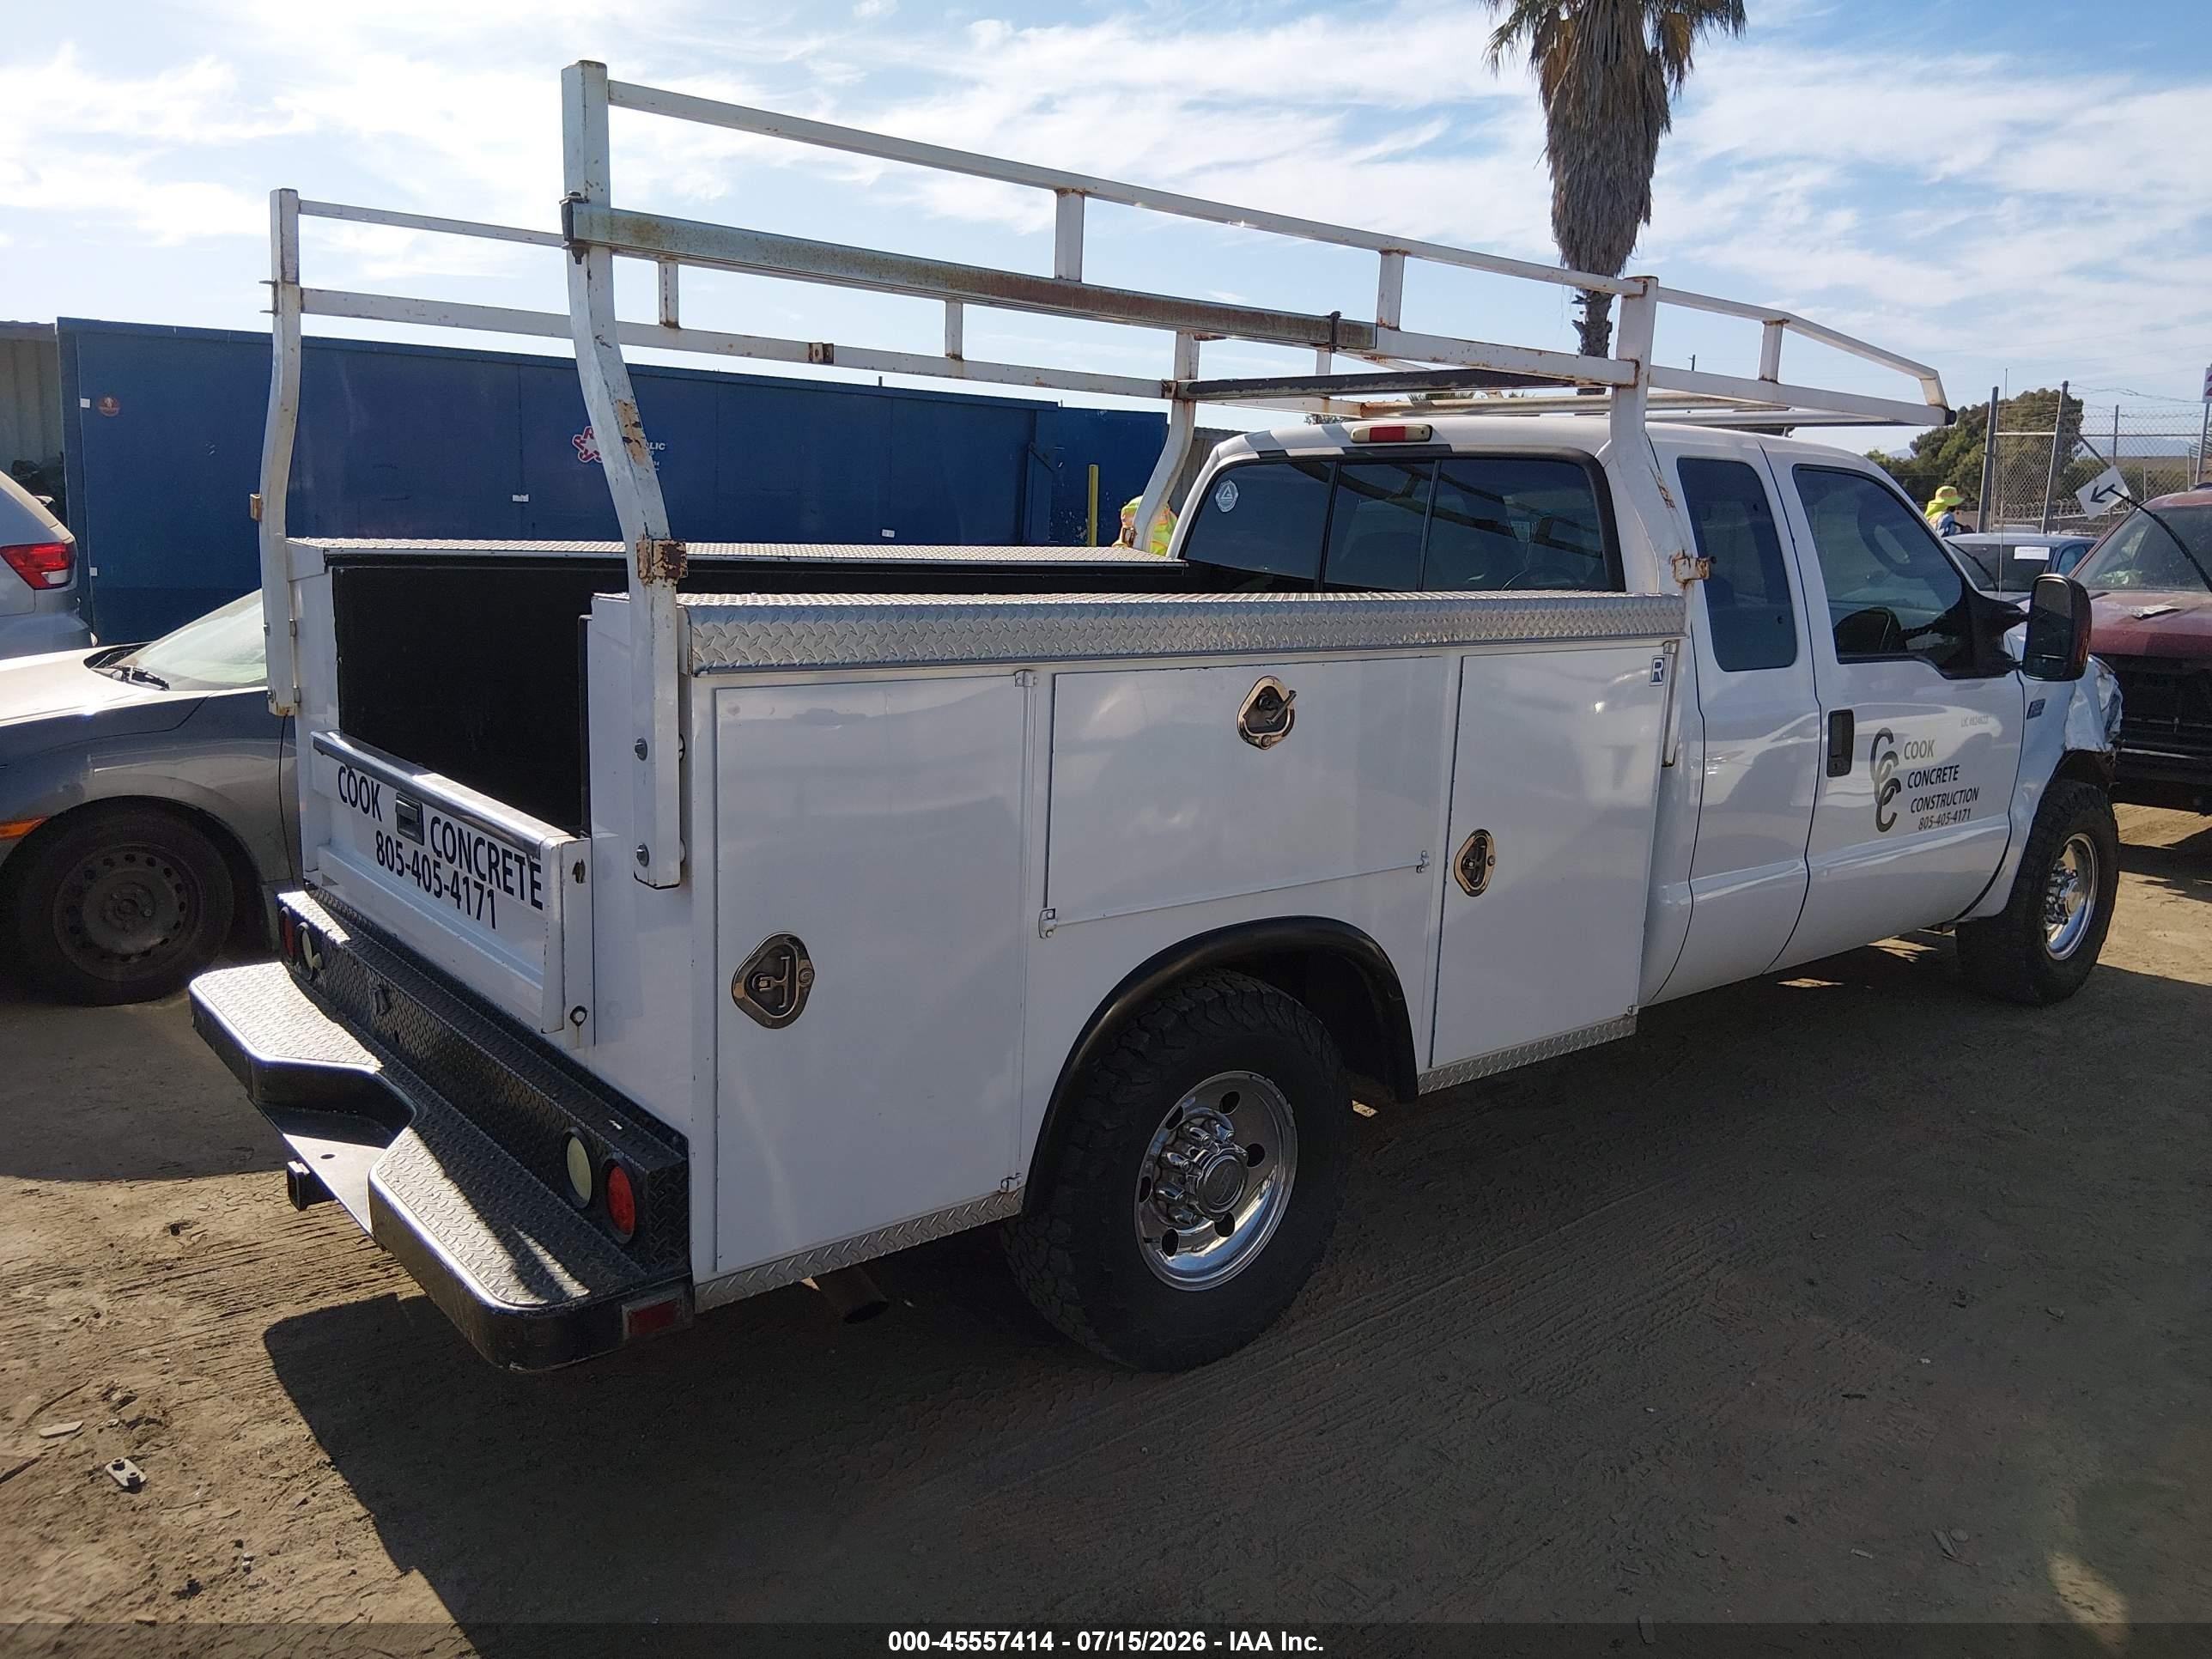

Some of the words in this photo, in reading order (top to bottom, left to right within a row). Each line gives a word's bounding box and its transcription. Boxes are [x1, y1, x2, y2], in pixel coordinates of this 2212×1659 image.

[1651, 659, 1663, 681] R
[1904, 739, 1935, 760] COOK
[1907, 764, 1960, 789] CONCRETE
[1911, 786, 1980, 814] CONSTRUCTION
[1917, 808, 1972, 831] 805-405-4171
[337, 766, 382, 822] COOK
[429, 816, 544, 911] CONCRETE
[375, 830, 496, 930] 805-405-4171
